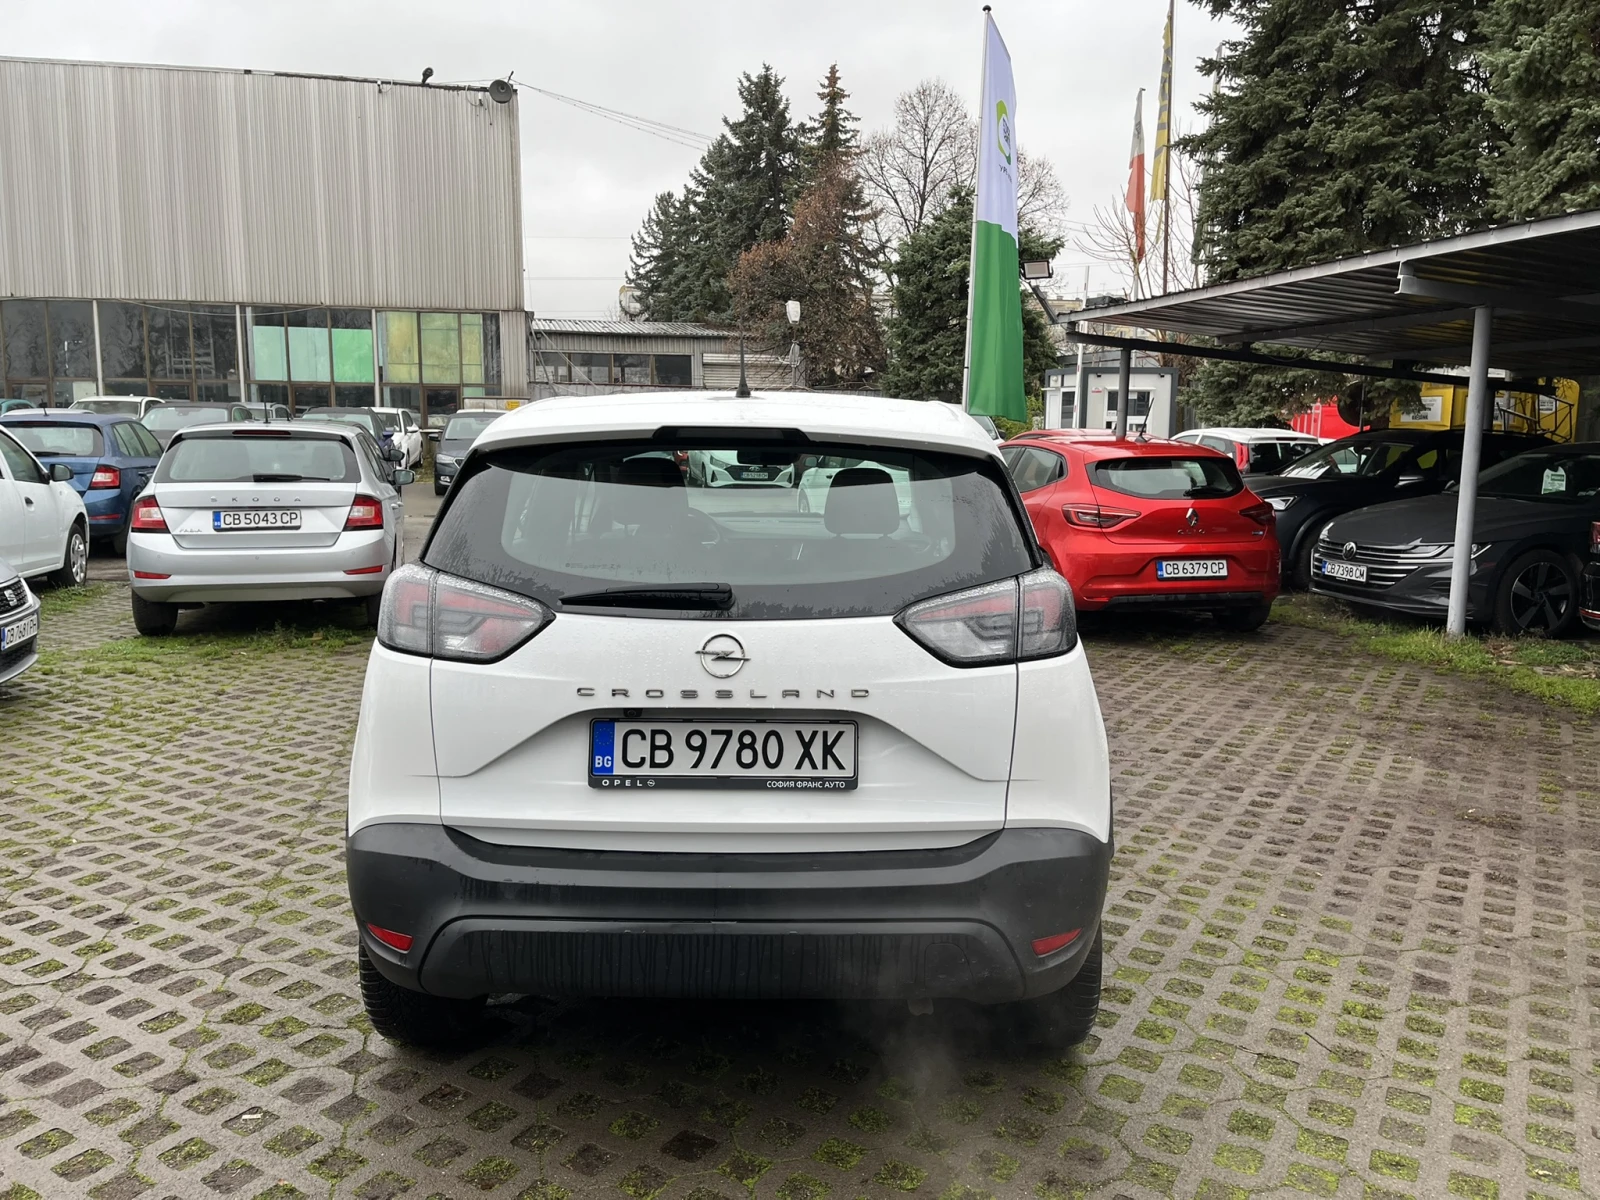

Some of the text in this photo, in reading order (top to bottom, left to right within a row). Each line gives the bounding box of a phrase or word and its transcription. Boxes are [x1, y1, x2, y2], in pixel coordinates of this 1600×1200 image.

[223, 512, 298, 525] CB 5043 CP
[1164, 562, 1225, 575] CB 6379 CP
[1326, 563, 1336, 574] CB
[1336, 565, 1354, 578] 7398
[1354, 568, 1365, 580] CM
[576, 687, 870, 698] CROSSLAND
[621, 729, 846, 770] CB 9780 XK
[595, 756, 612, 768] BG
[602, 779, 643, 787] OPEL
[766, 780, 846, 789] СОФИЯ ФРАНС АУТО
